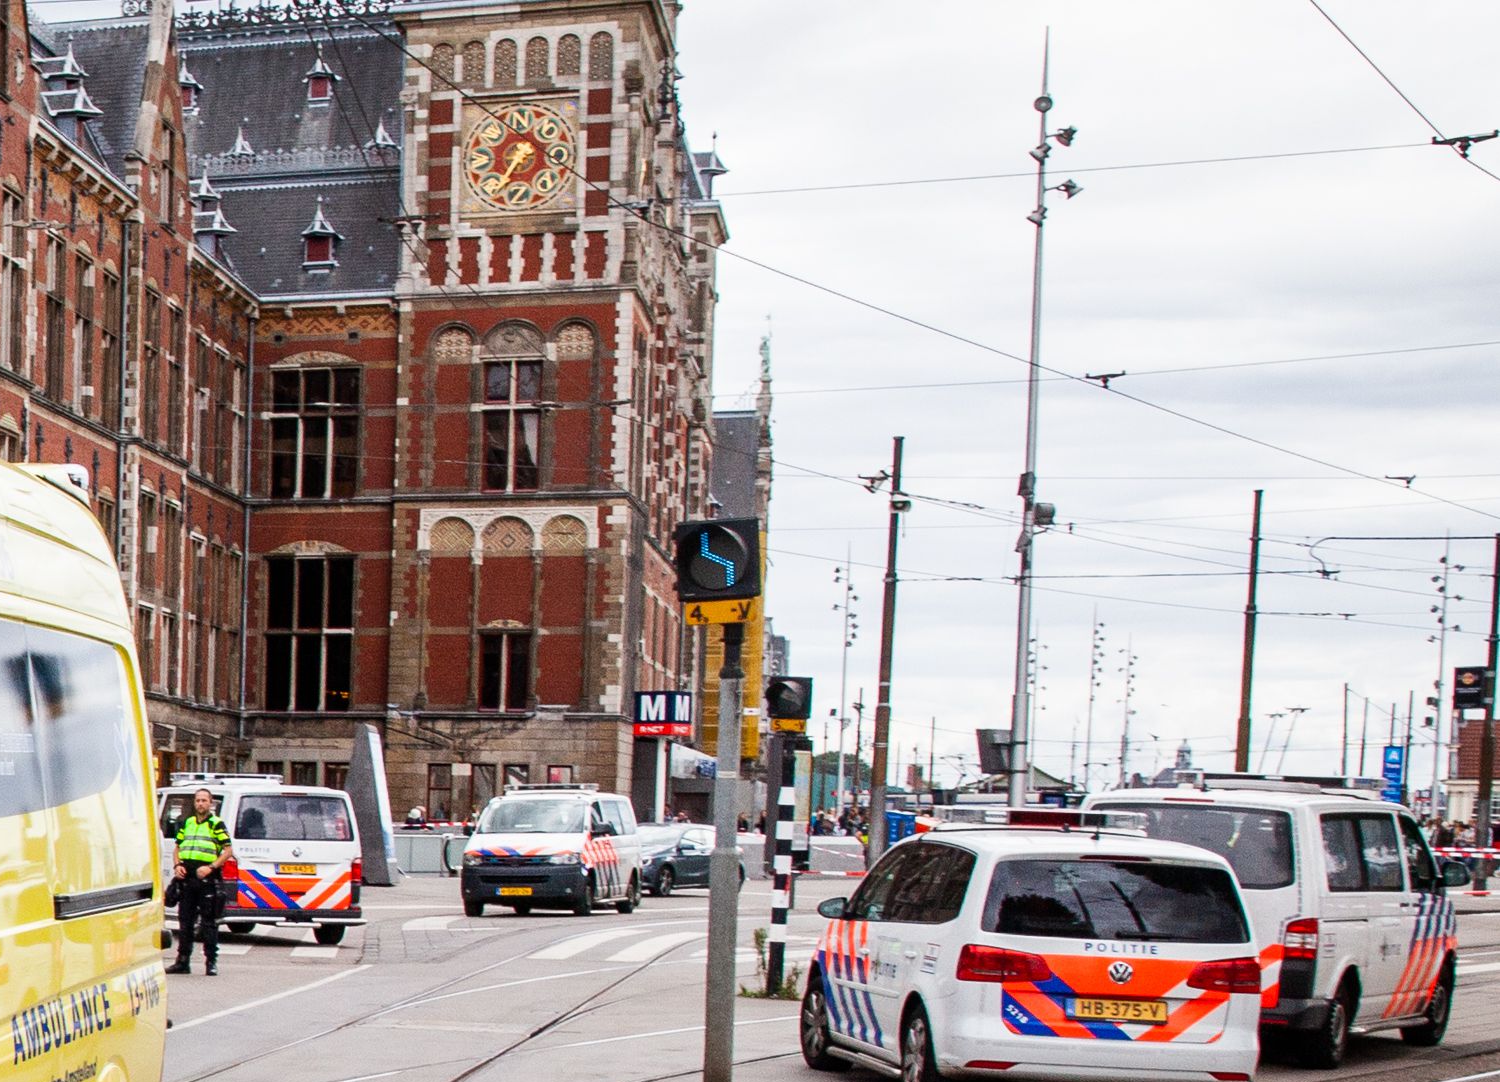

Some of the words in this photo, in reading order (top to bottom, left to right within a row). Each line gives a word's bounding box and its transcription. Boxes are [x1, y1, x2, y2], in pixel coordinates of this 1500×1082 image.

[513, 111, 528, 129] N
[511, 187, 528, 204] Z
[640, 695, 666, 721] M
[674, 695, 690, 721] M
[1085, 943, 1158, 955] POLITIE
[11, 984, 112, 1065] AMBULANCE
[126, 966, 160, 1017] 13-106
[1081, 1001, 1160, 1018] HB-375-V
